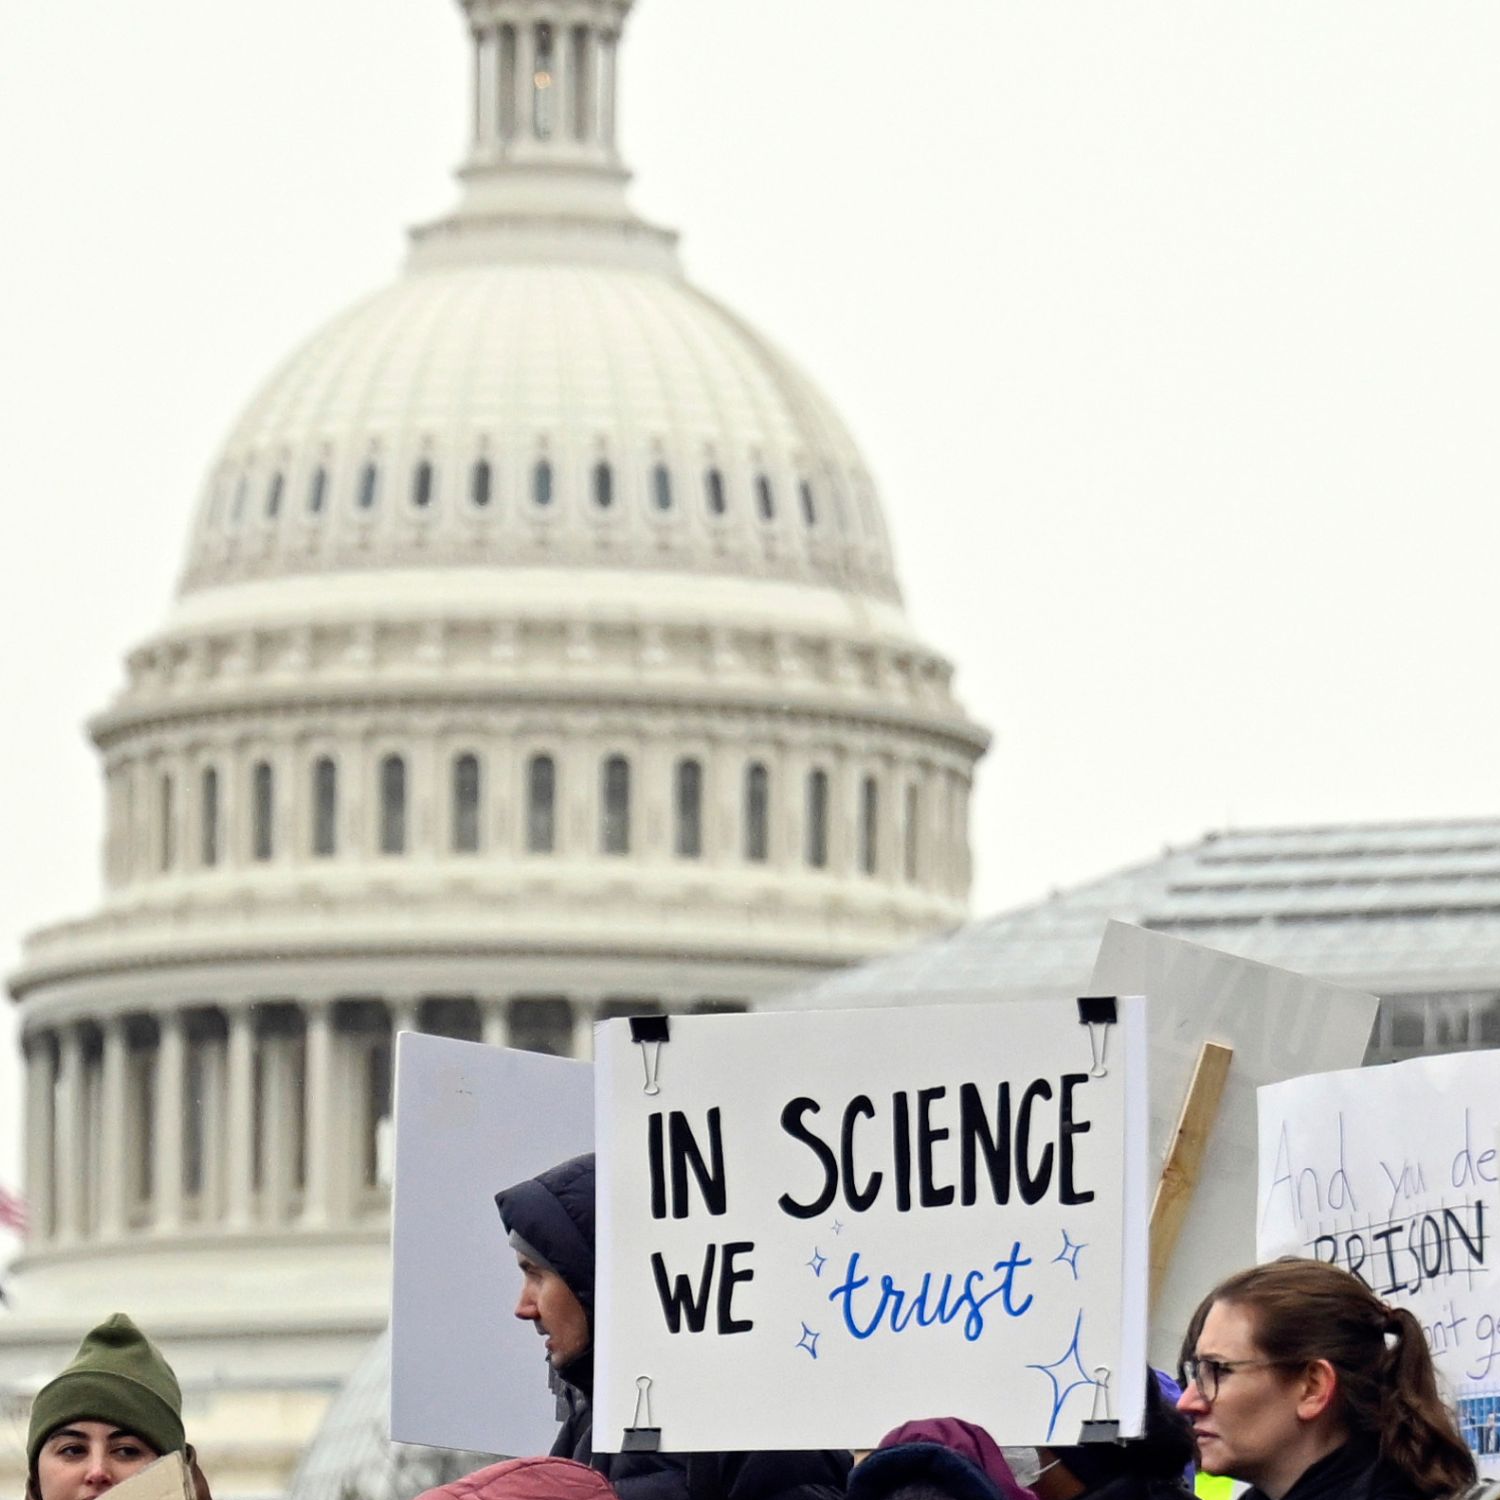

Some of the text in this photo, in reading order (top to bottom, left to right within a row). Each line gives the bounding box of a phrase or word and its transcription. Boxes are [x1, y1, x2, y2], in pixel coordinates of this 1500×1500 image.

[647, 1073, 1096, 1220] IN SCIENCE
[1262, 1111, 1357, 1228] And
[650, 1240, 1034, 1342] WE trust
[1314, 1199, 1484, 1296] PRISON
